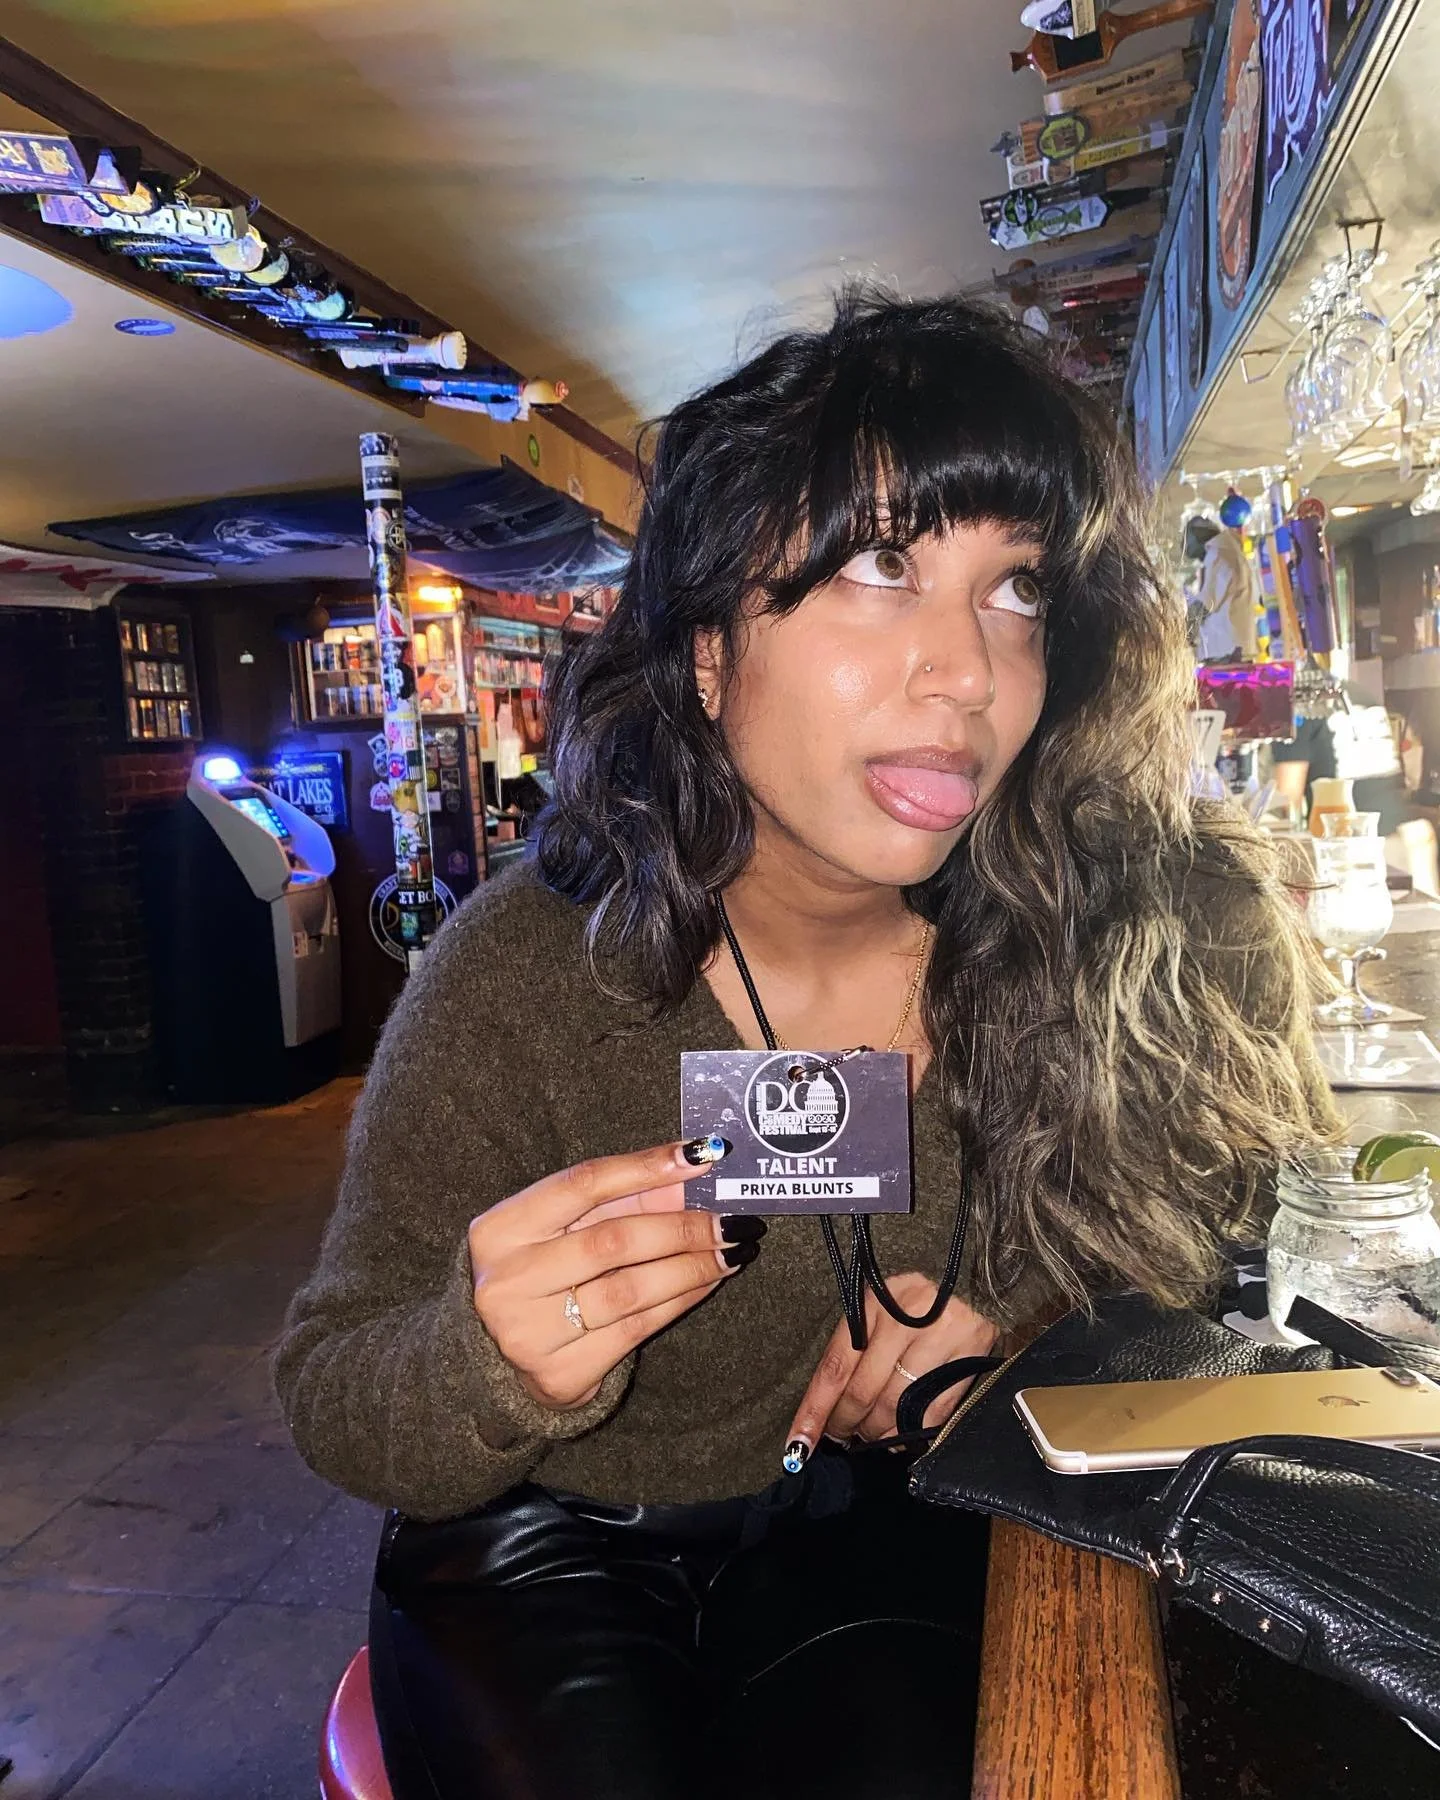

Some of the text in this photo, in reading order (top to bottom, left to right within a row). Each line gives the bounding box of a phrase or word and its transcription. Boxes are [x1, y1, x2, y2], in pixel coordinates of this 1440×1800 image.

[287, 778, 333, 805] LAKES
[759, 1125, 808, 1135] FESTIVAL
[757, 1157, 837, 1175] TALENT
[740, 1182, 854, 1196] PRIYA BLUNTS
